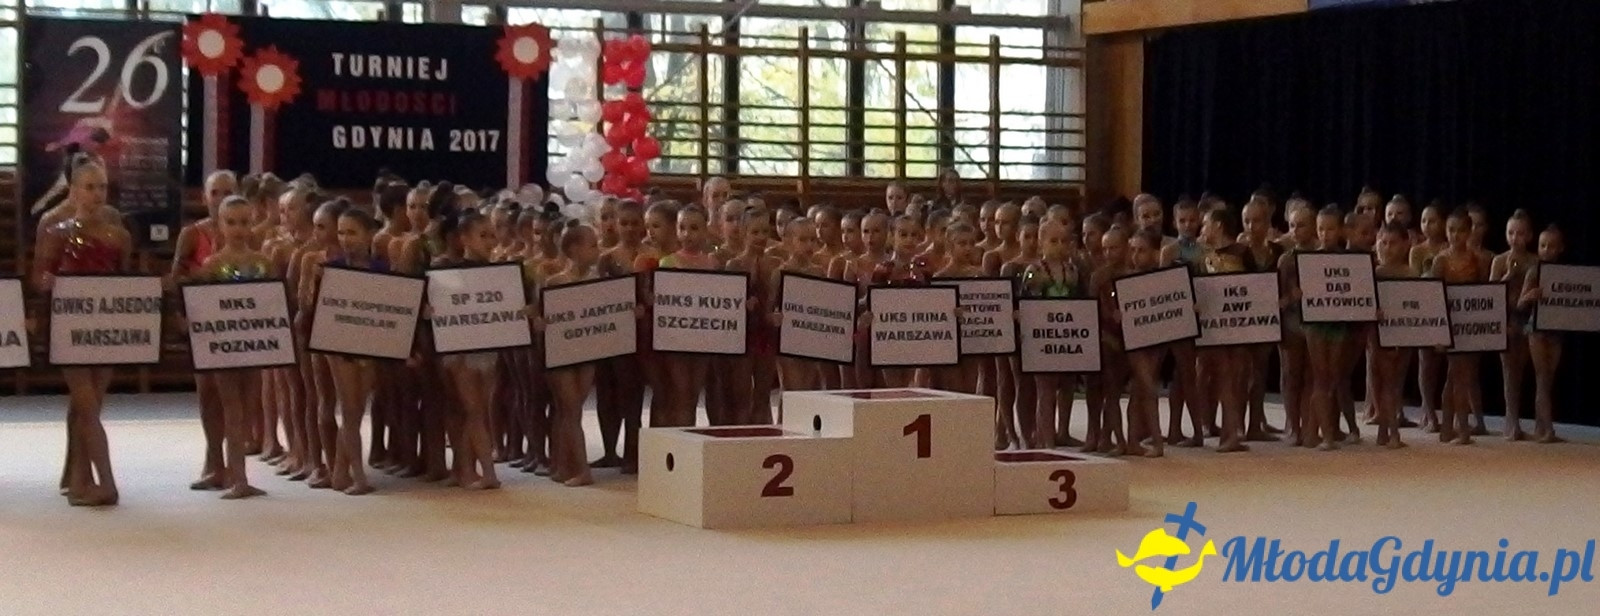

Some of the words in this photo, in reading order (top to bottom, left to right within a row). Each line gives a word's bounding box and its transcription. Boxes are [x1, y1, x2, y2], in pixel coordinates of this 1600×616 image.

[58, 30, 176, 113] 26
[332, 52, 448, 80] TURNIEJ
[332, 125, 434, 150] GDYNIA
[450, 129, 500, 152] 2017
[1324, 268, 1350, 277] UKS
[1224, 286, 1248, 297] IKS
[1551, 282, 1592, 292] LEGION
[219, 297, 256, 310] MKS
[450, 292, 470, 305] SP
[477, 290, 503, 303] 220
[657, 294, 693, 308] MKS
[698, 296, 743, 310] KUSY
[1124, 298, 1147, 312] PTG
[1306, 297, 1374, 308] KATOWICE
[1464, 297, 1494, 312] ORION
[52, 297, 94, 314] GWKS
[547, 310, 576, 324] UKS
[580, 301, 636, 319] JANTAR
[434, 310, 527, 328] WARSZAWA
[657, 316, 738, 331] SZCZECIN
[879, 312, 908, 323] UKS
[912, 312, 948, 323] IRINA
[1047, 312, 1074, 323] SGA
[1201, 315, 1280, 330] WARSZAWA
[564, 322, 617, 340] GDYNIA
[791, 319, 846, 334] WARSZAWA
[1033, 328, 1090, 339] BIELSKO
[71, 329, 151, 346] WARSZAWA
[875, 330, 954, 342] WARSZAWA
[903, 413, 932, 459] 1
[761, 454, 795, 498] 2
[1047, 469, 1077, 510] 3
